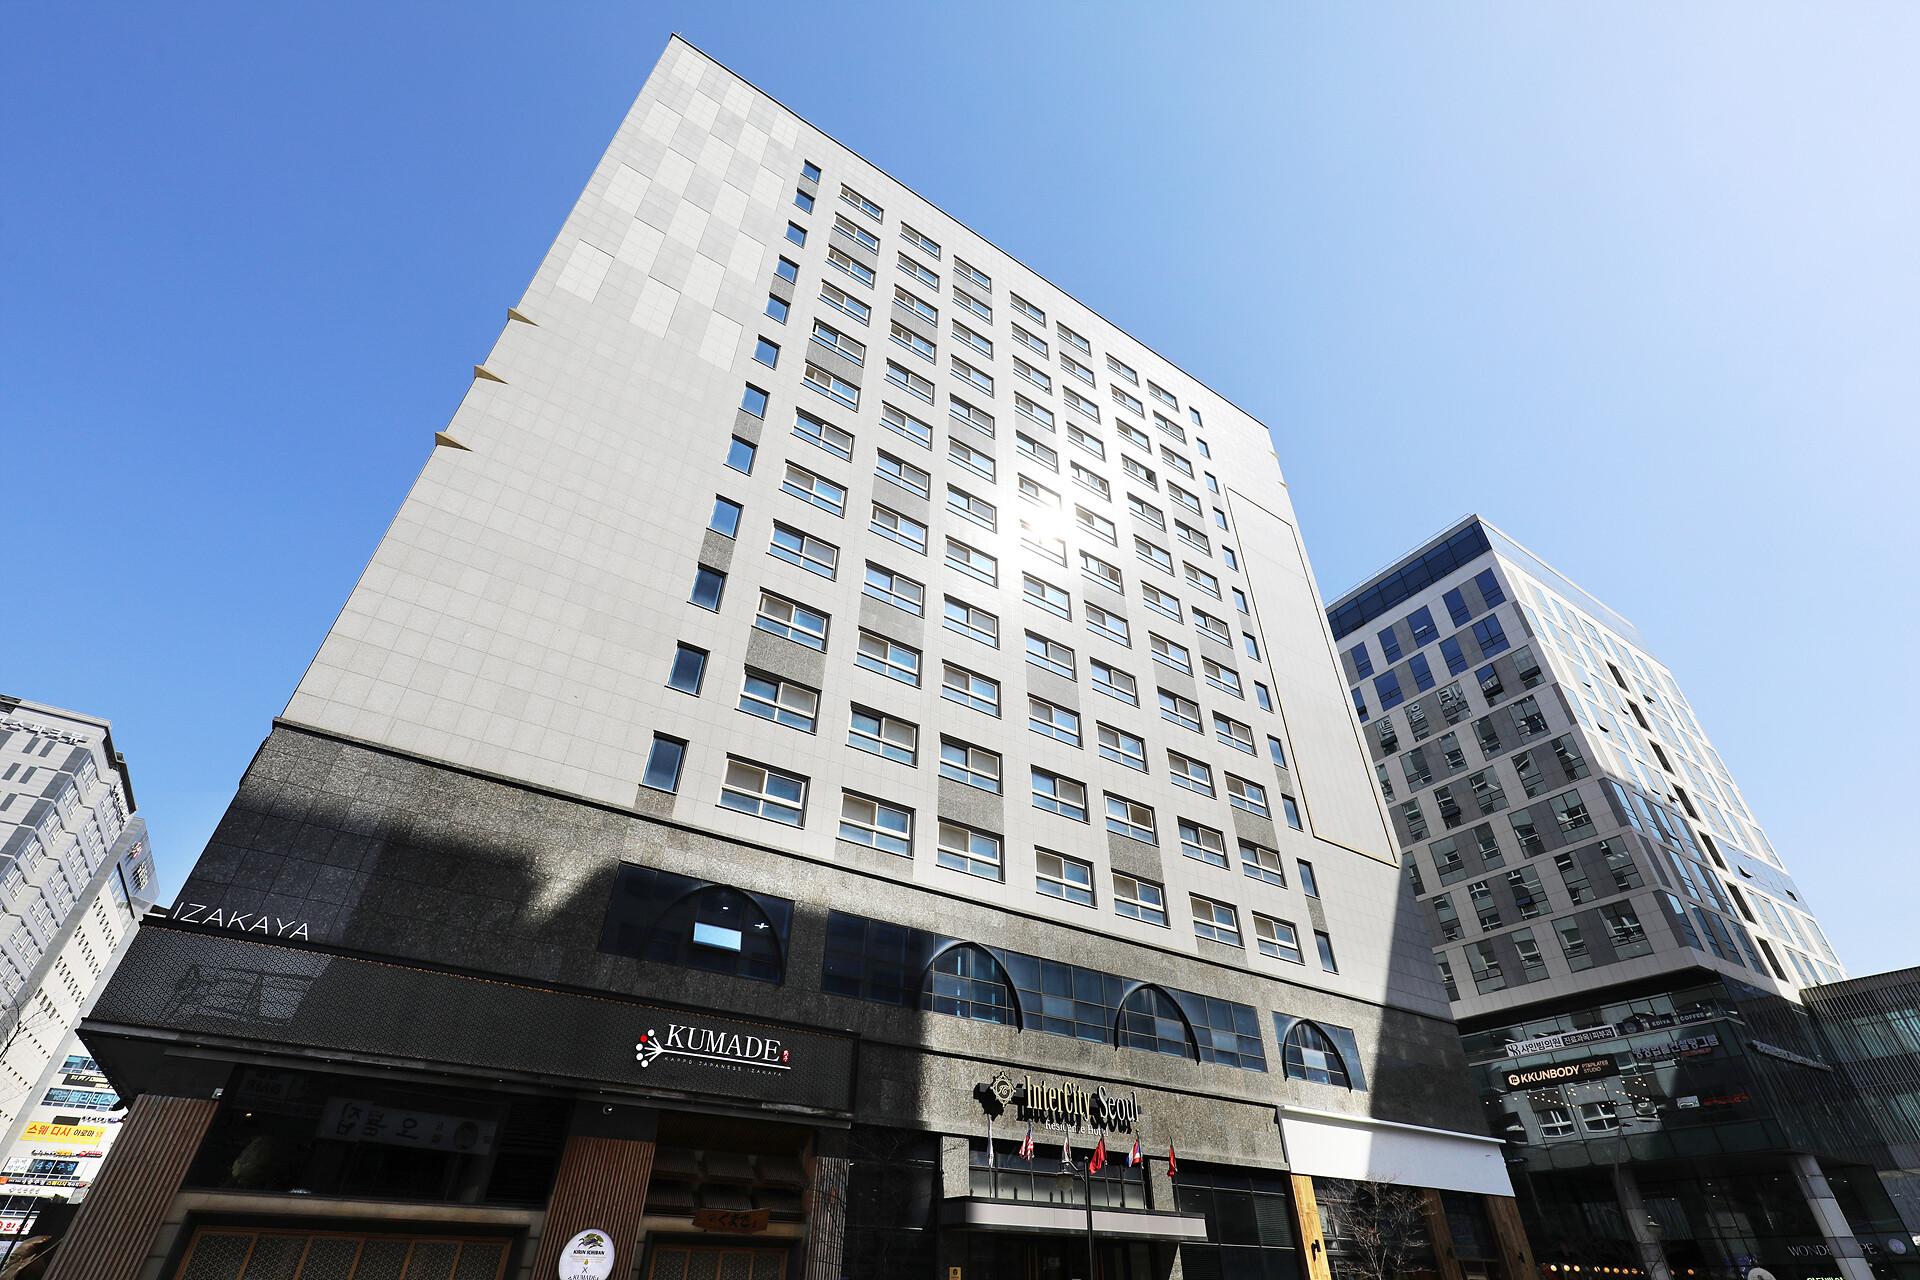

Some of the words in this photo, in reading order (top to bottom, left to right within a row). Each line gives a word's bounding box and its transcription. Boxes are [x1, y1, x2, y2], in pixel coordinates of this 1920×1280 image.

[172, 901, 309, 941] IZAKAYA
[1651, 1018, 1672, 1027] EDIYA
[1679, 1012, 1706, 1022] COFFEE
[664, 1023, 782, 1063] KUMADE
[664, 1056, 692, 1065] KAPPO
[698, 1061, 741, 1072] JAPANESE
[747, 1067, 781, 1077] IZAKAYA
[1520, 1065, 1580, 1083] KKUNBODY
[1026, 1075, 1091, 1122] InterCity
[1098, 1085, 1140, 1123] Seoul
